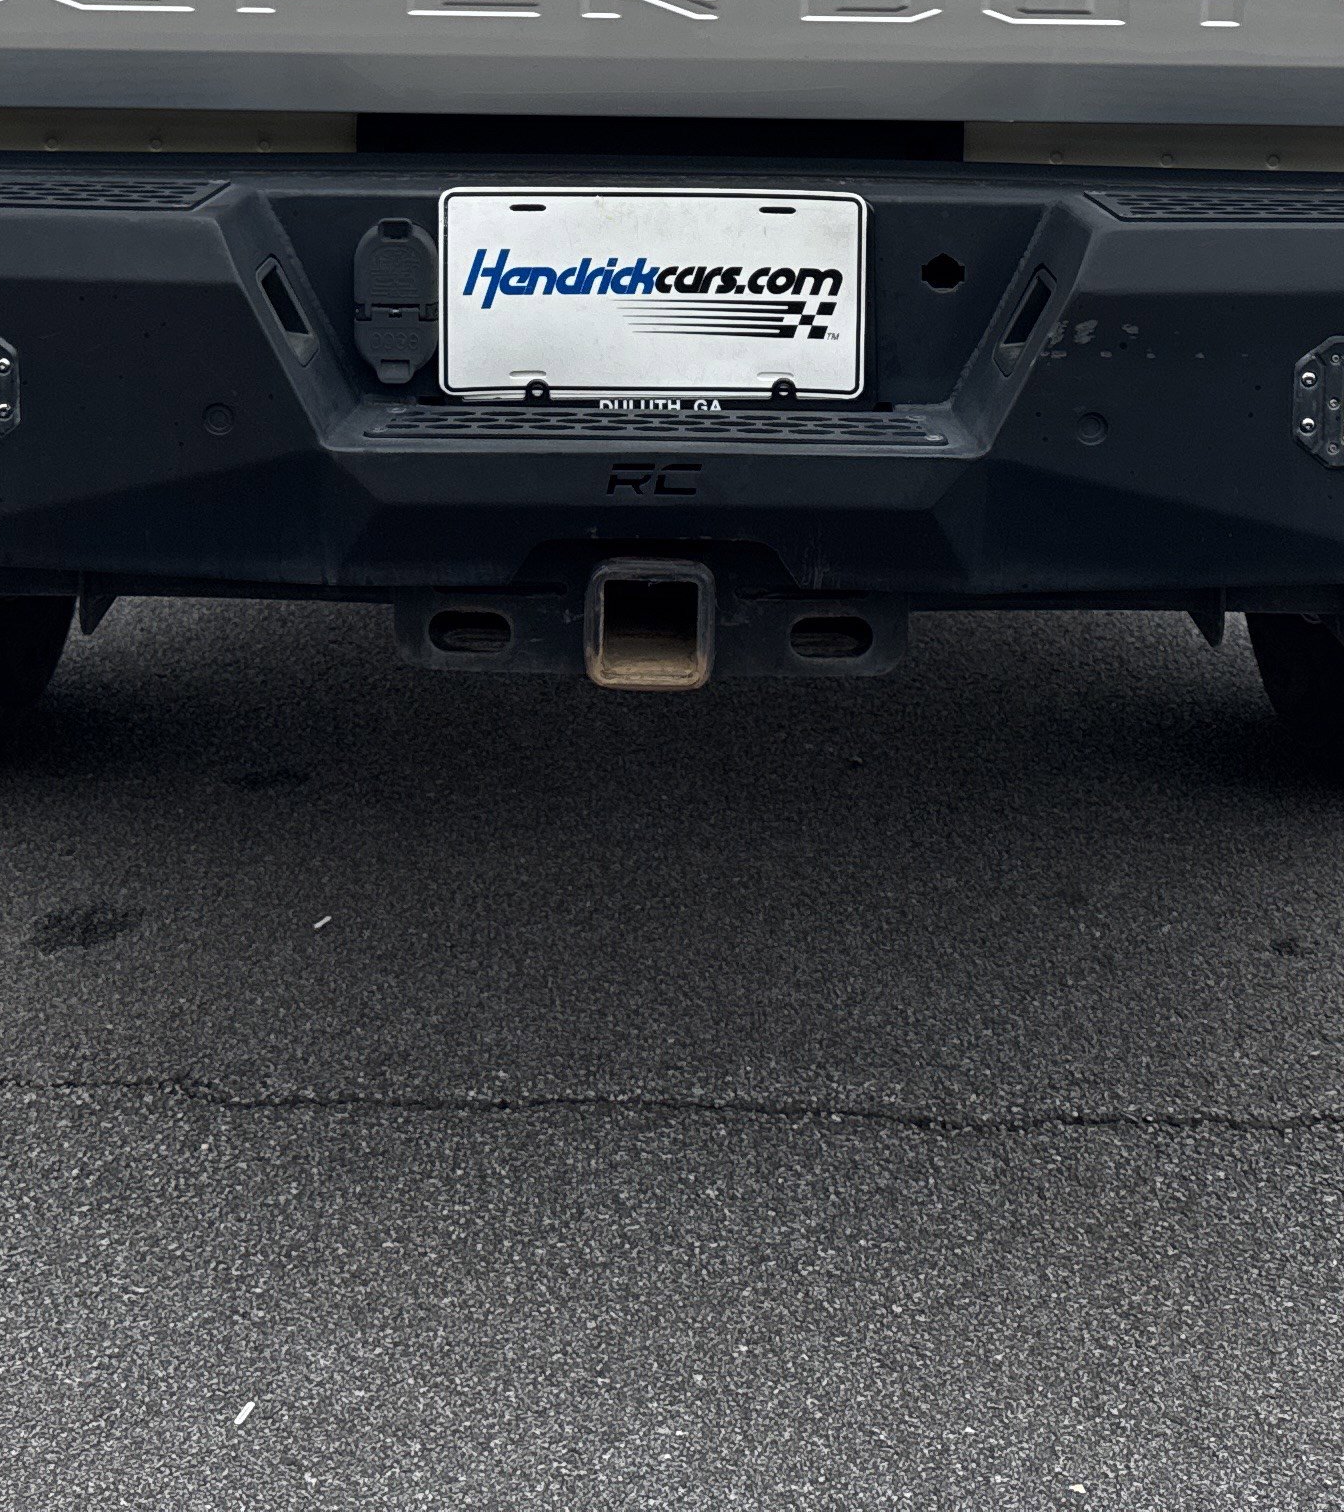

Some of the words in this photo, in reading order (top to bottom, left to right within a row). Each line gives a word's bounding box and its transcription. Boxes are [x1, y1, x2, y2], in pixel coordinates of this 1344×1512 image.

[462, 248, 844, 309] Hendrickcars.com
[599, 399, 681, 411] DULUTH
[693, 399, 722, 411] GA
